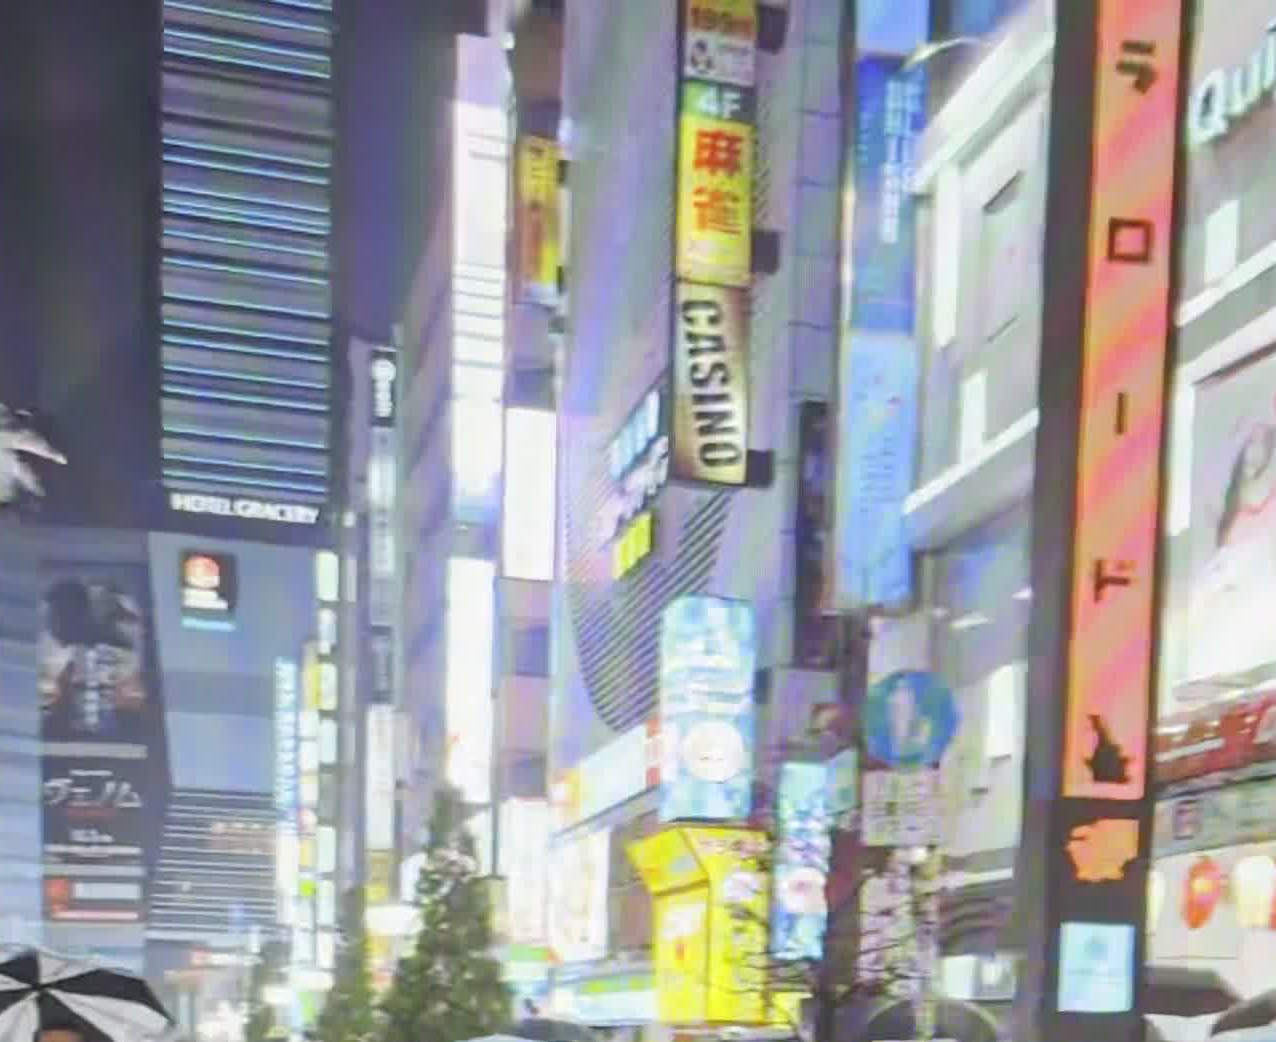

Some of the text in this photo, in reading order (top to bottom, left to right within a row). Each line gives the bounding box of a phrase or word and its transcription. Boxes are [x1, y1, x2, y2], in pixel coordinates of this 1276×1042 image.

[694, 127, 745, 235] 麻雀
[682, 299, 742, 469] CASINO
[170, 492, 319, 524] HOTEL GRACERY
